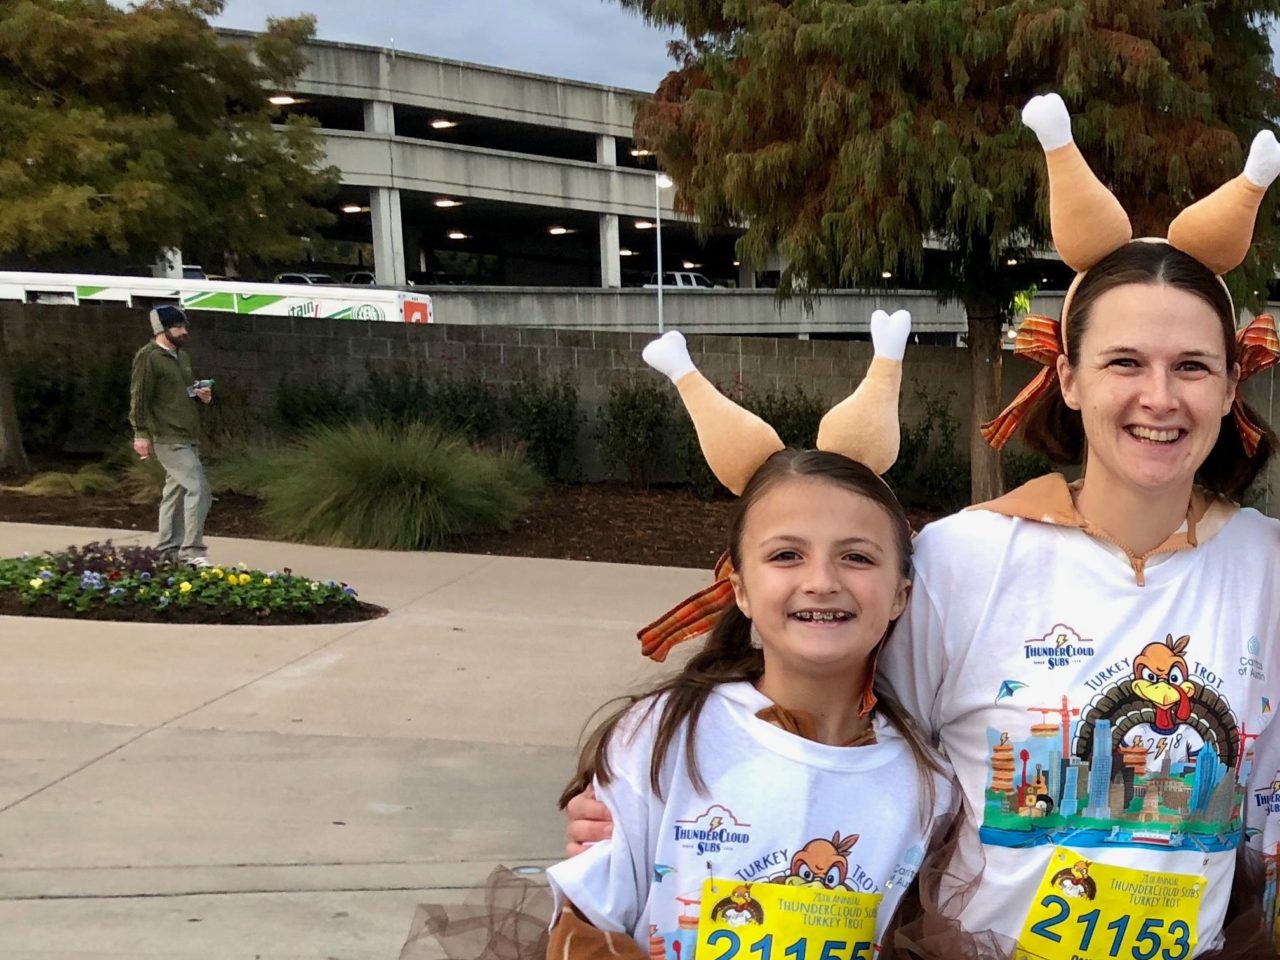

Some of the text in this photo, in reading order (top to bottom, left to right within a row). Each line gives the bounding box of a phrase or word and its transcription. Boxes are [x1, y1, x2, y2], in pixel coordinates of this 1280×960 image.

[1083, 658, 1225, 692] TURKEY TROT
[735, 849, 789, 881] TURKEY
[855, 863, 880, 893] TROT
[1130, 893, 1161, 907] TURKEY
[803, 913, 864, 930] TURKEY TROT
